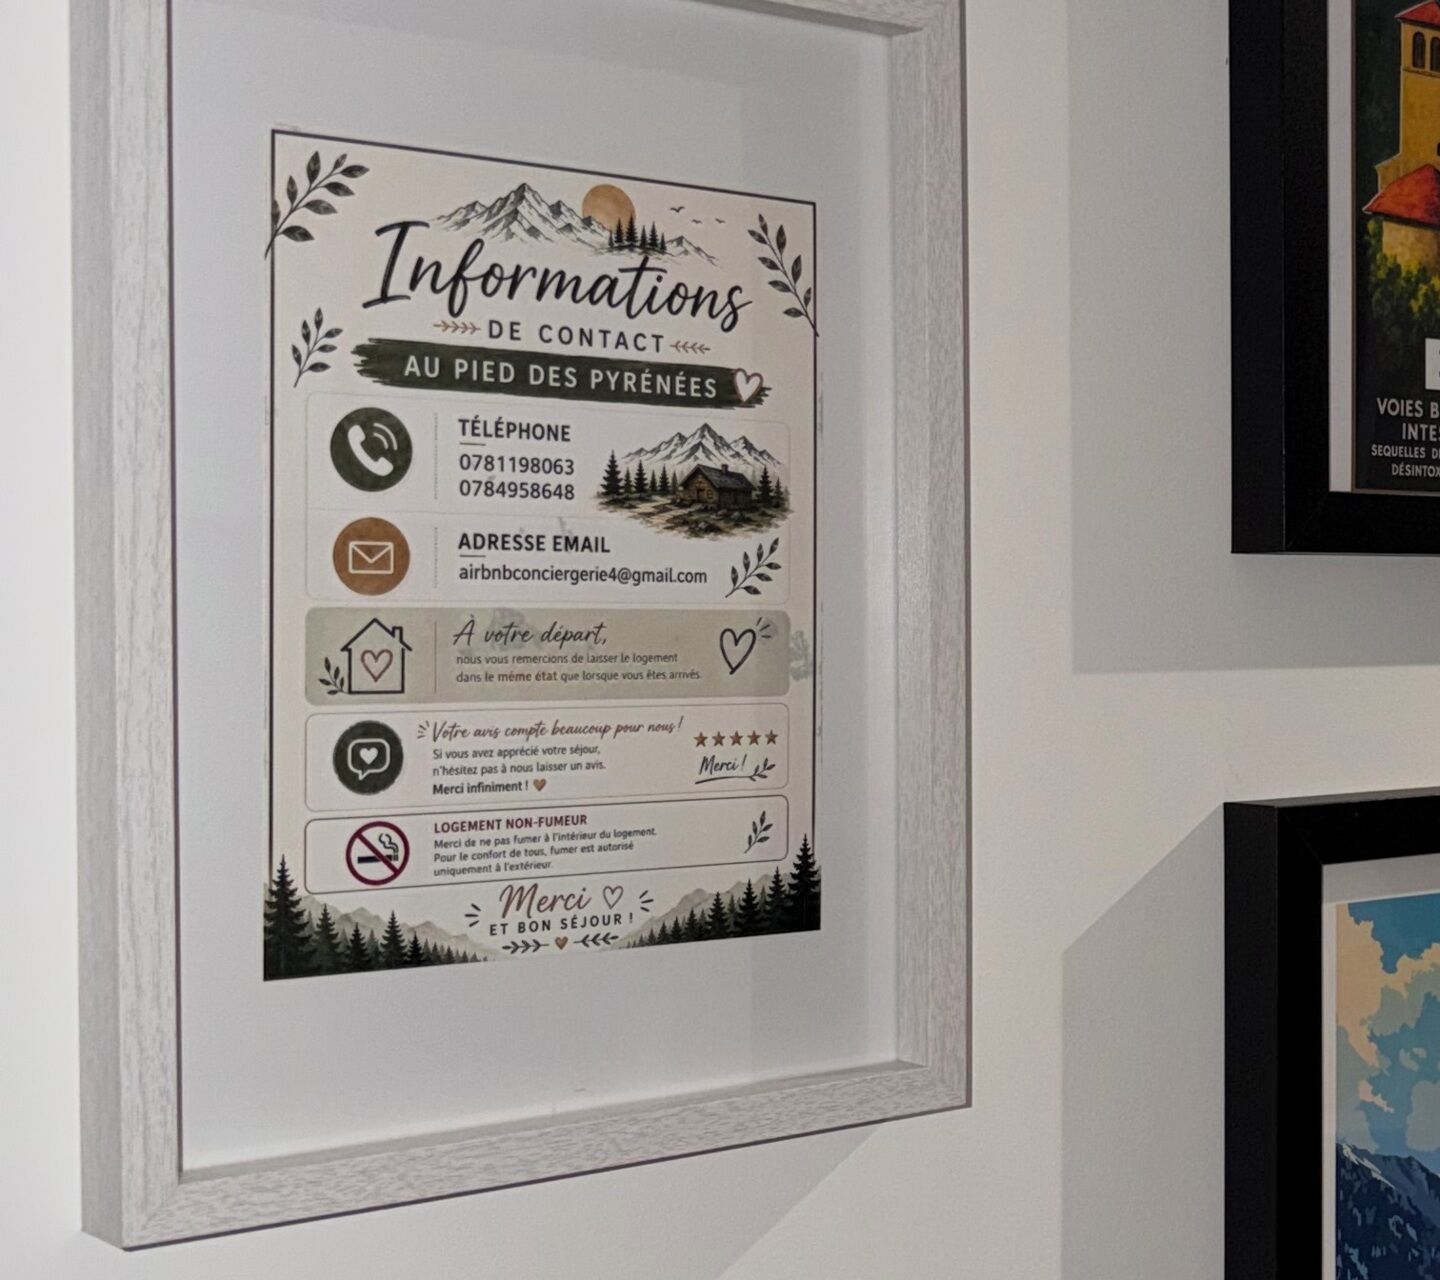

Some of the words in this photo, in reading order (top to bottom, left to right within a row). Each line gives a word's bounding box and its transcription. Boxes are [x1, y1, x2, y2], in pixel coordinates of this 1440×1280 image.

[361, 220, 753, 332] Informations
[488, 320, 521, 341] DE
[539, 325, 664, 353] CONTACT
[404, 355, 440, 379] AU
[454, 358, 515, 384] PIED
[529, 365, 577, 388] DES
[591, 368, 717, 398] PYRÉNÉES
[1376, 397, 1423, 418] VOIES
[458, 415, 571, 442] TÉLÉPHONE
[1371, 444, 1426, 458] SEQUELLES
[459, 454, 574, 476] 0781198063
[459, 480, 575, 501] 0784958648
[458, 533, 546, 551] ADRESSE
[552, 535, 610, 553] EMAIL
[459, 564, 708, 586] airbnbconciergerie4@gmail.com
[453, 614, 475, 646] À
[484, 622, 534, 644] votre
[540, 621, 608, 649] départ,
[457, 655, 482, 665] nous
[485, 654, 509, 665] vous
[512, 652, 568, 665] remercions
[571, 652, 584, 664] de
[586, 652, 618, 664] laisser
[621, 652, 630, 663] le
[633, 652, 678, 665] logement
[456, 671, 482, 683] dans
[485, 671, 494, 683] le
[535, 671, 558, 683] état
[561, 672, 580, 683] que
[582, 670, 619, 683] lorsque
[622, 671, 643, 680] vous
[646, 668, 666, 680] êtes
[432, 722, 470, 742] Votre
[474, 723, 500, 739] avis
[504, 720, 548, 741] compte
[551, 719, 611, 739] beaucoup
[614, 722, 644, 738] pour
[433, 748, 443, 759] Si
[445, 749, 469, 759] vous
[472, 749, 494, 759] avez
[497, 745, 539, 760] apprécié
[542, 745, 567, 756] votre
[570, 744, 600, 758] séjour,
[433, 764, 477, 776] n'hésitez
[480, 764, 498, 777] pas
[501, 762, 507, 774] à
[510, 763, 533, 773] nous
[536, 760, 567, 772] laisser
[570, 762, 583, 771] un
[585, 760, 606, 771] avis.
[432, 782, 464, 795] Merci
[467, 779, 522, 794] infiniment
[434, 819, 501, 834] LOGEMENT
[506, 814, 587, 830] NON-FUMEUR
[434, 837, 461, 849] Merci
[465, 836, 476, 847] de
[479, 837, 491, 847] ne
[494, 836, 510, 848] pas
[514, 834, 541, 845] fumer
[544, 832, 550, 843] à
[552, 831, 597, 843] l'intérieur
[599, 830, 611, 839] du
[434, 853, 456, 863] Pour
[459, 851, 468, 862] le
[471, 850, 506, 861] confort
[509, 847, 521, 858] de
[524, 847, 547, 858] tous,
[550, 844, 577, 855] fumer
[580, 843, 594, 853] est
[597, 841, 634, 852] autorisé
[434, 864, 492, 877] uniquement
[495, 861, 501, 873] à
[499, 883, 592, 919] Merci
[490, 923, 508, 936] ET
[518, 920, 551, 934] BON
[560, 914, 622, 930] SÉJOUR
